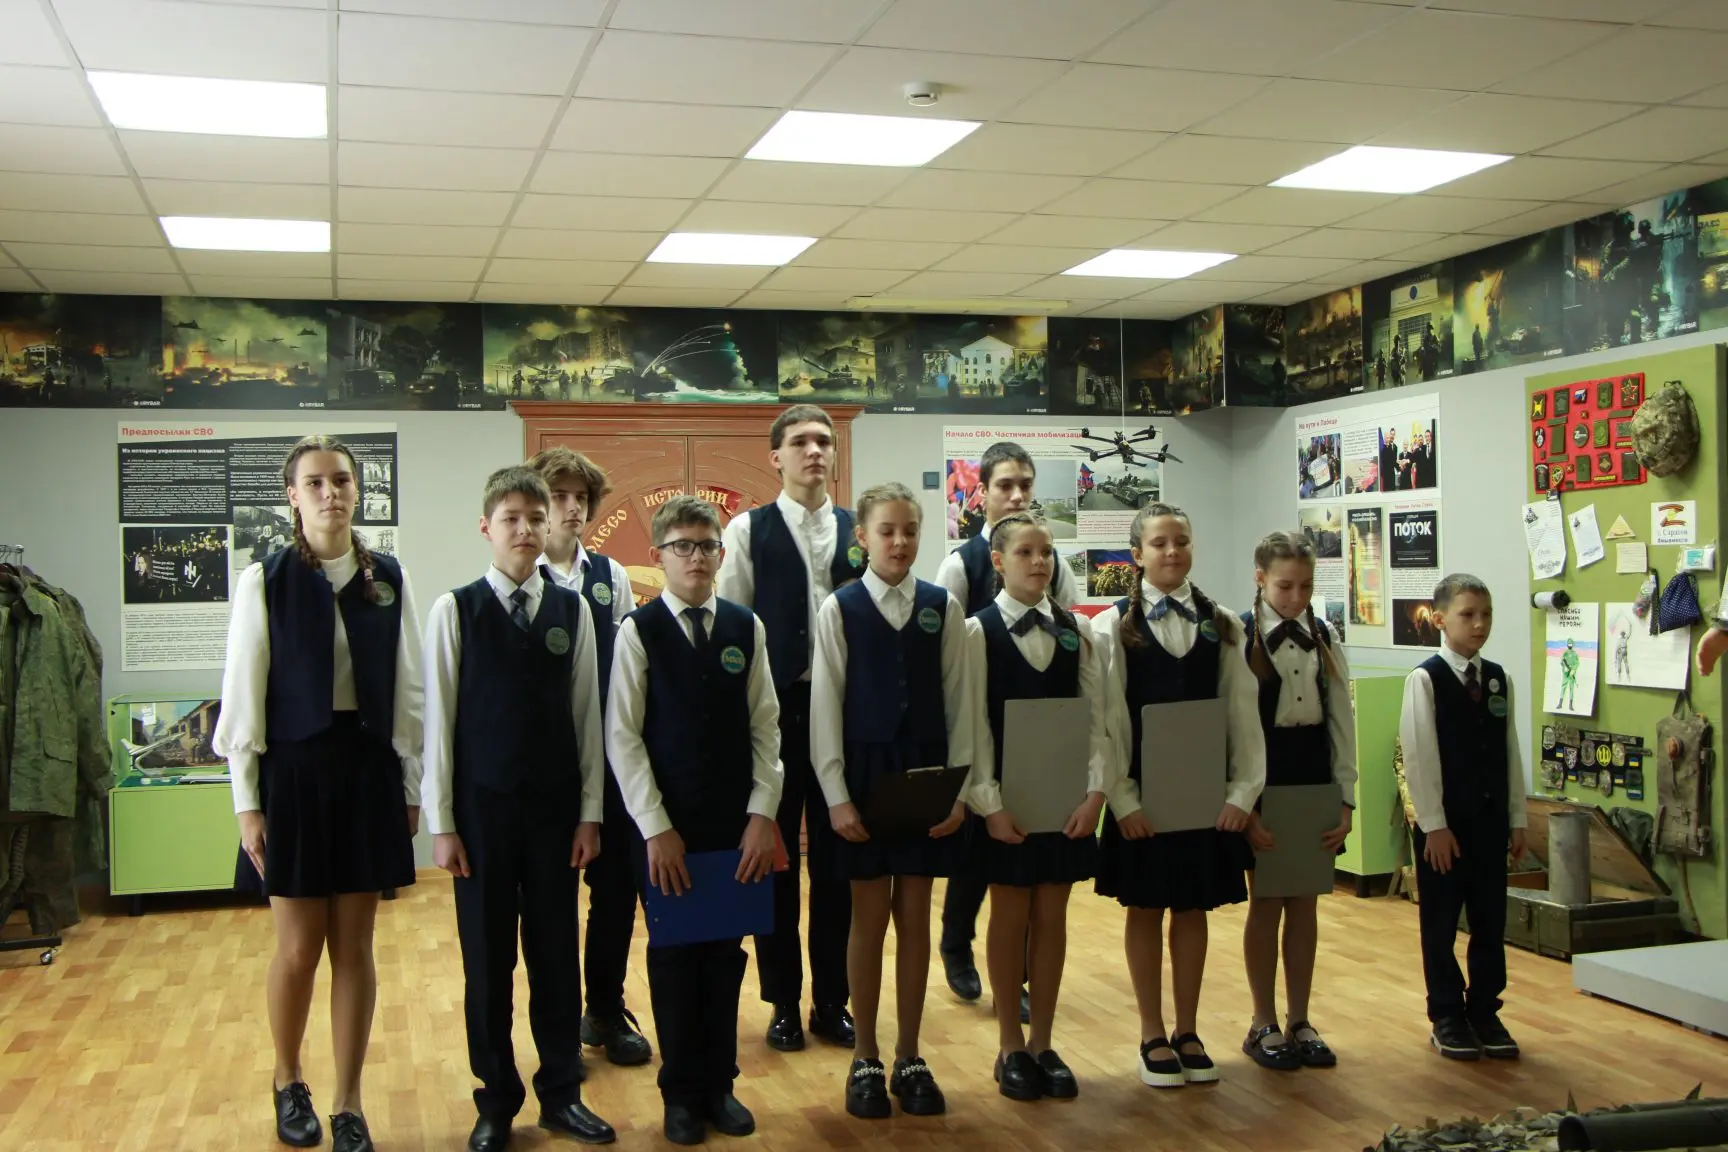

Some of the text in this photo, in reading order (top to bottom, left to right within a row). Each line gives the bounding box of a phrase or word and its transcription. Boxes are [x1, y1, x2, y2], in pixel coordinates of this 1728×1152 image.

[122, 428, 213, 437] Предпосылки СВО
[585, 509, 628, 554] ОЛЕСО
[1394, 520, 1432, 537] ПОТОК
